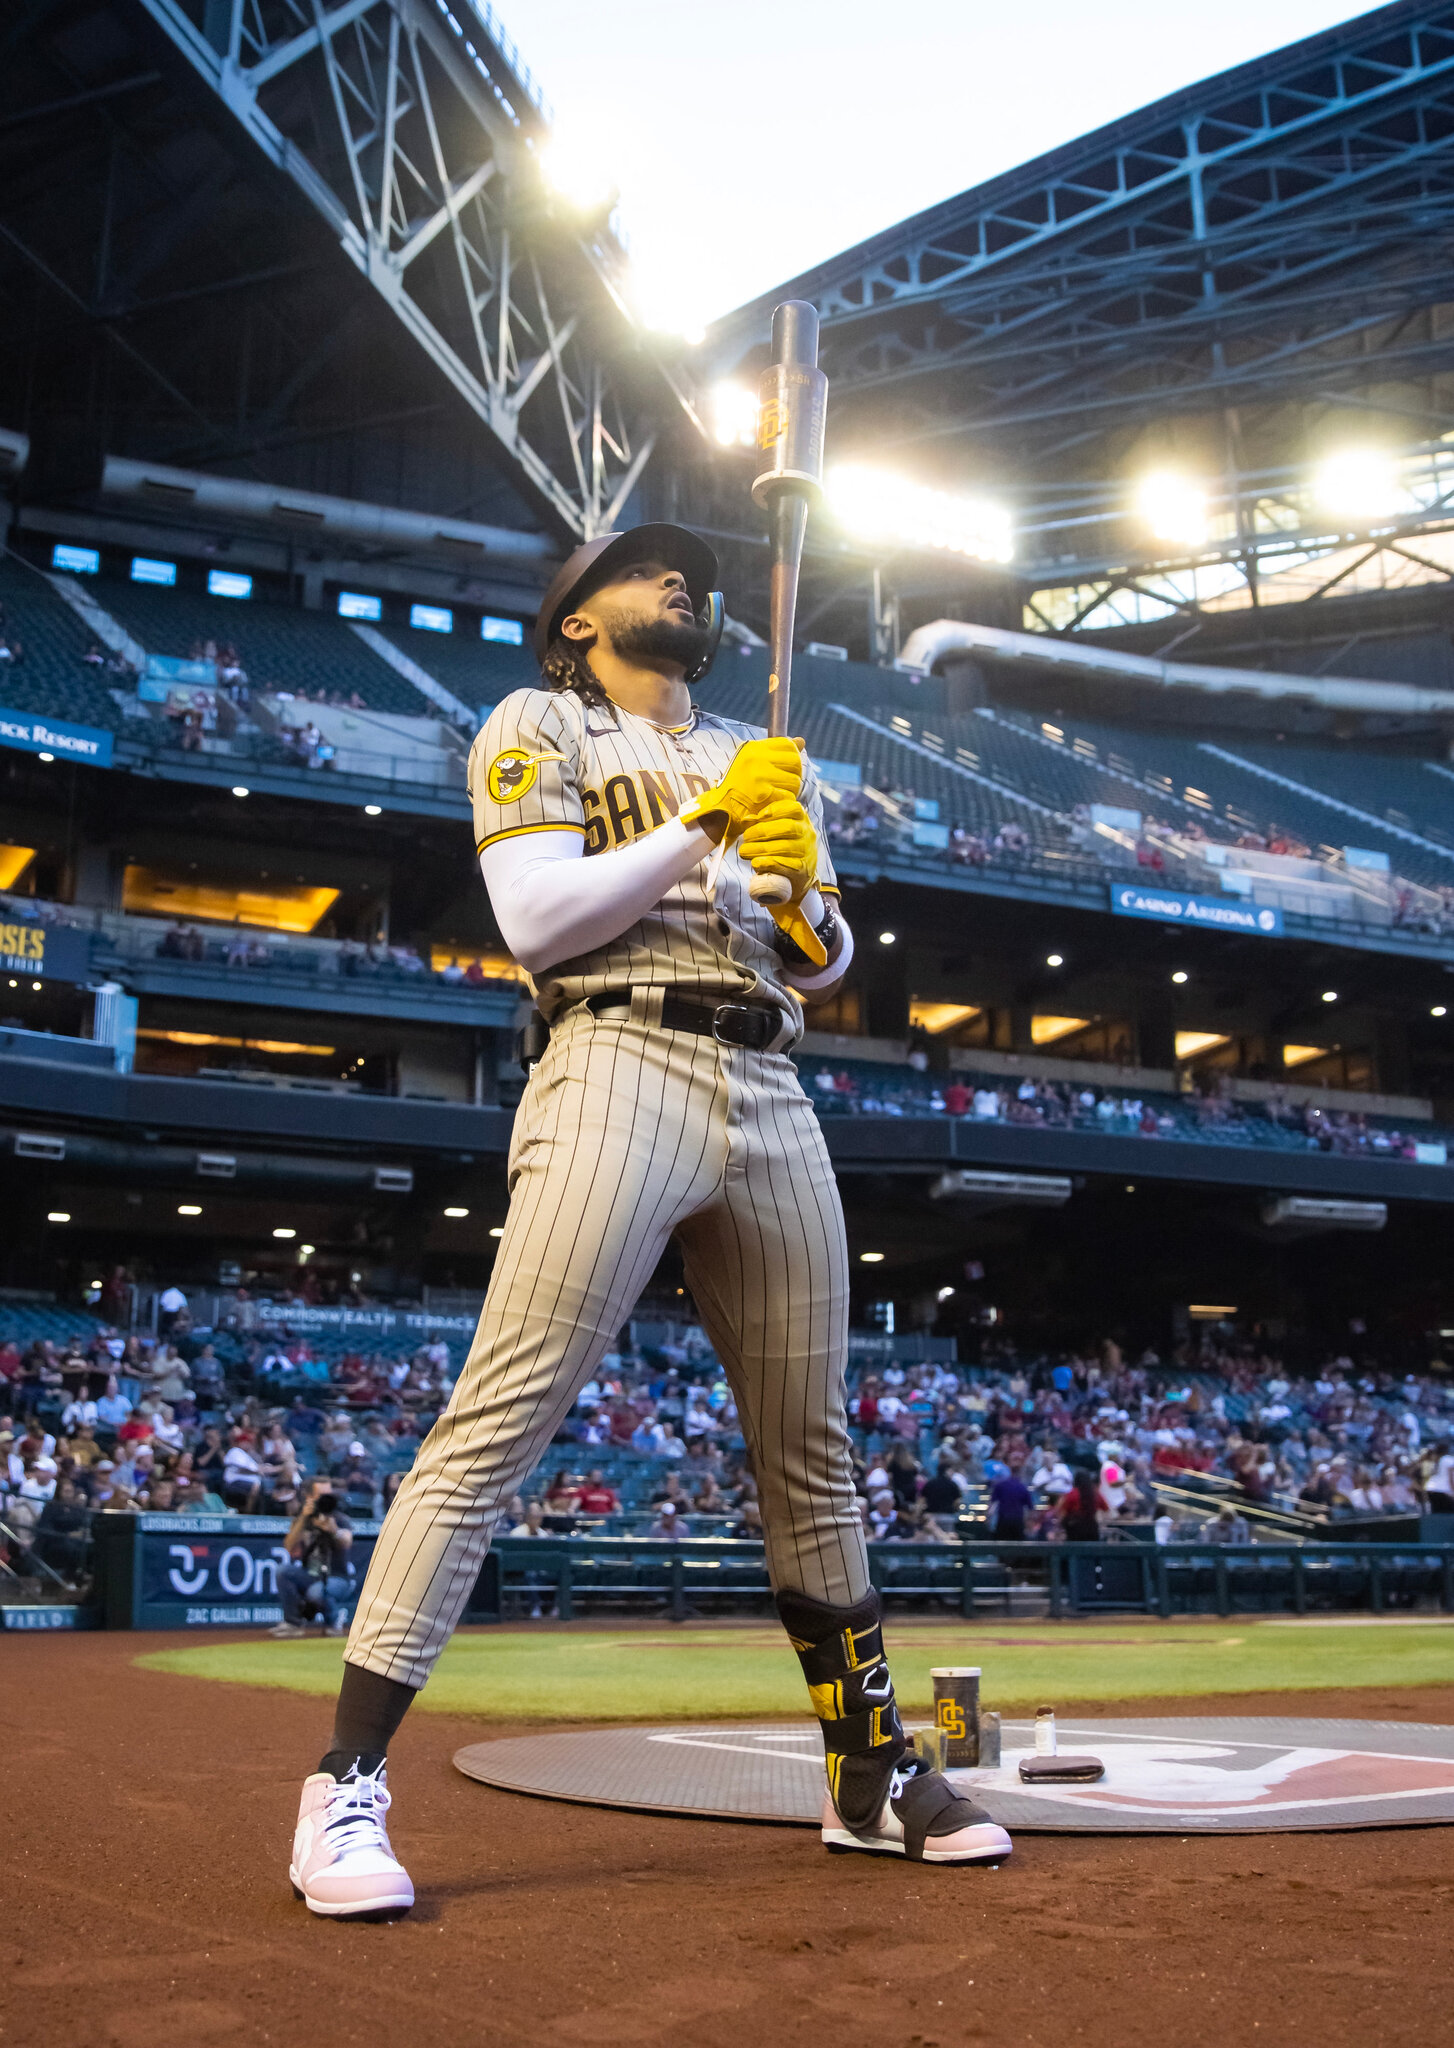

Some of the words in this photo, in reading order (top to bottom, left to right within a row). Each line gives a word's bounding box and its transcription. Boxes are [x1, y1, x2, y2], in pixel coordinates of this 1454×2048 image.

[0, 720, 31, 742] ICK
[581, 770, 680, 857] SAN
[1120, 890, 1182, 917] CASINO
[1184, 900, 1256, 928] ARIZONA
[0, 921, 46, 960] SES
[405, 1313, 476, 1332] TERRACE
